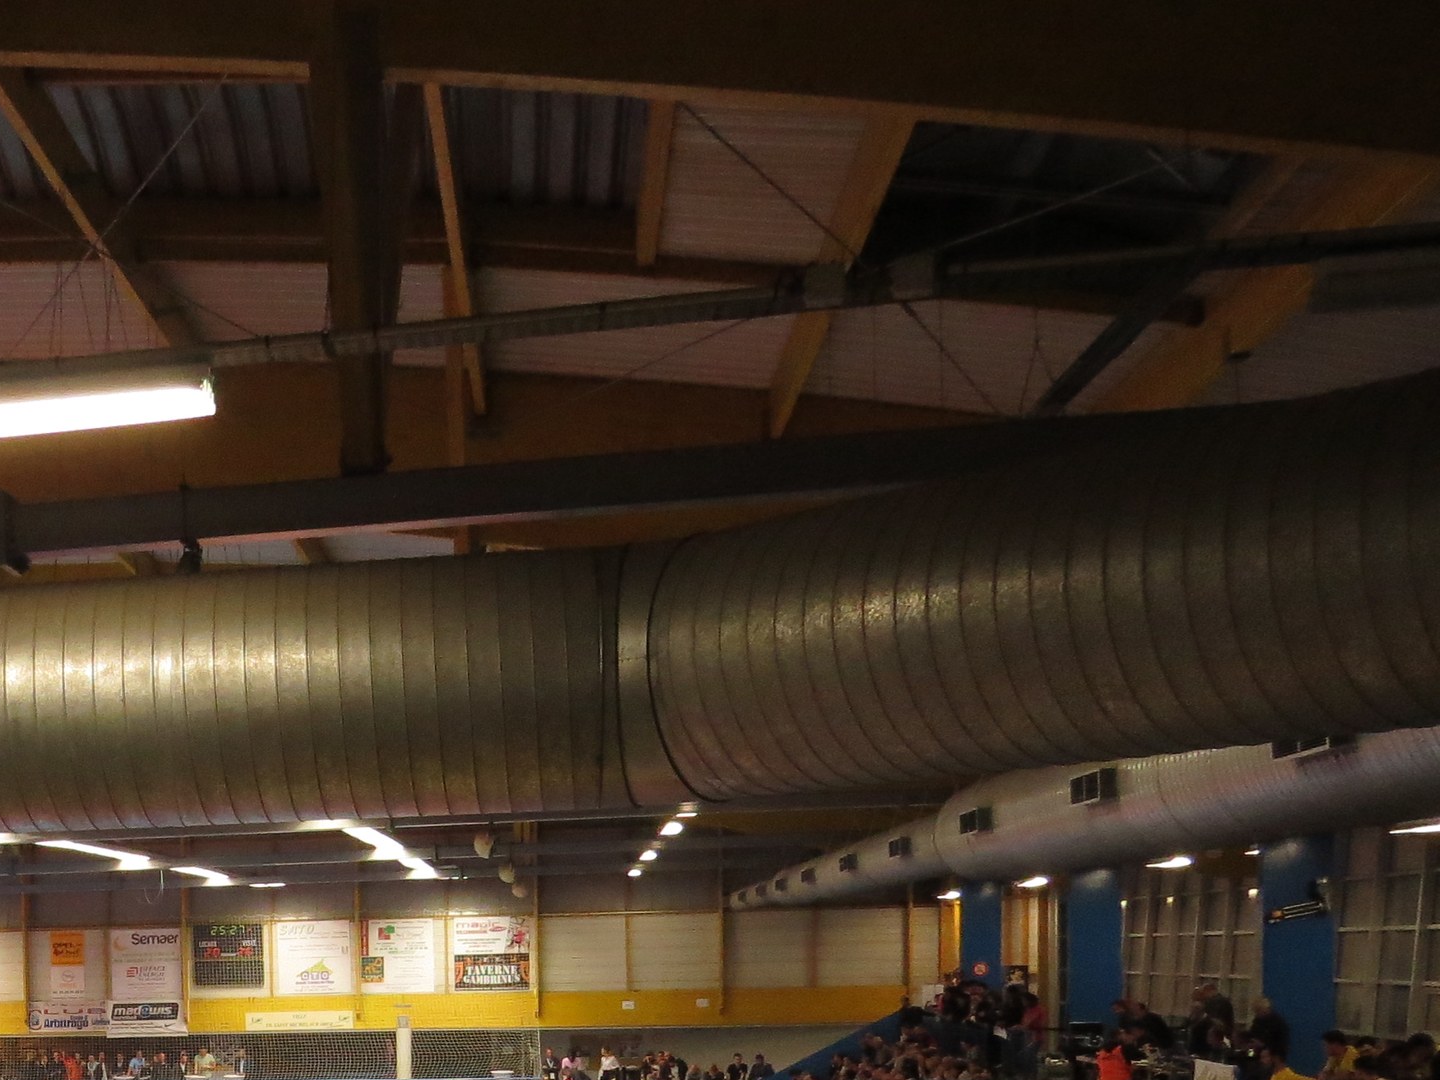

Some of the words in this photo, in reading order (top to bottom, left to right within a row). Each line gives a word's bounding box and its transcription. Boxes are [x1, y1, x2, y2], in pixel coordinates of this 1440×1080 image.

[131, 932, 178, 946] Semaer
[466, 965, 518, 976] TAVERNE
[463, 974, 520, 984] GAMBRINUS
